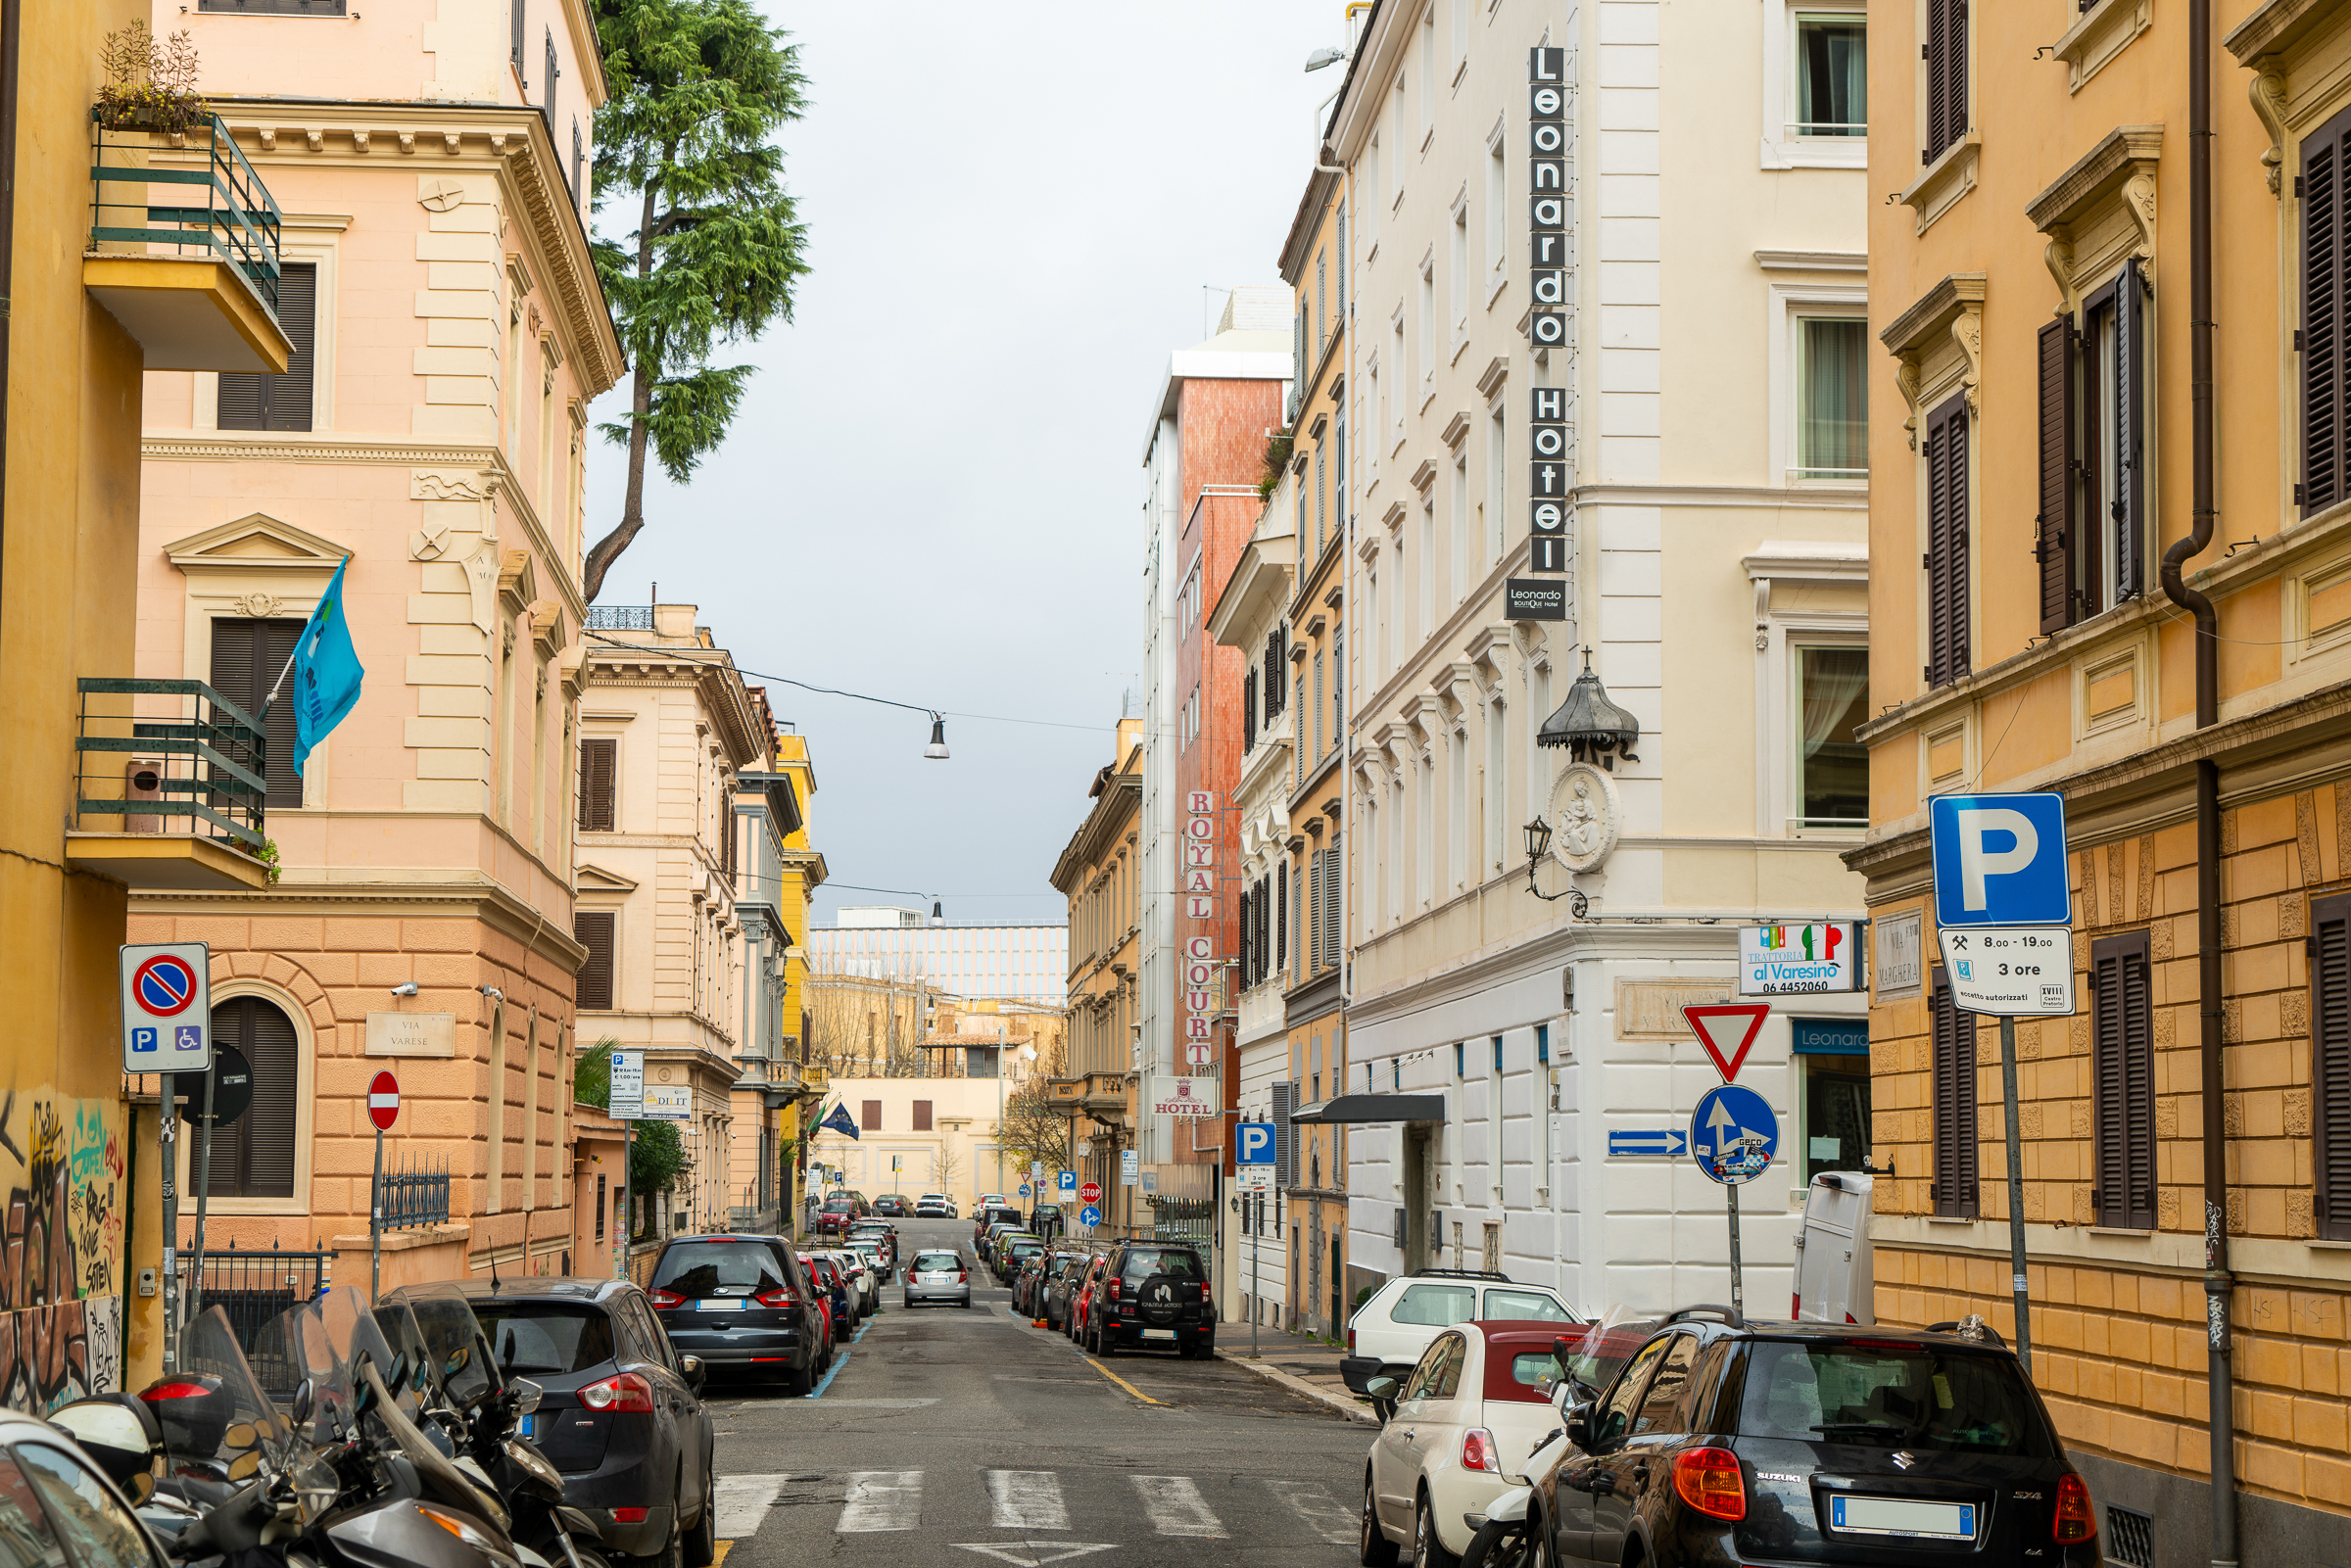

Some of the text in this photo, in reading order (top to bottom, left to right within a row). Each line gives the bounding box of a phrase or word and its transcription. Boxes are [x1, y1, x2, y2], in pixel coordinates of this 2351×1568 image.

[1535, 48, 1562, 569] Leonardo Hotel
[1511, 589, 1561, 600] Leonardo
[1958, 808, 2039, 912] P
[1188, 793, 1211, 1064] ROYAL COURT
[1892, 932, 1903, 950] VIA
[1984, 936, 2009, 948] 8.00
[2022, 936, 2053, 948] 19.00
[1748, 951, 1803, 963] TRATTORIA
[1753, 961, 1838, 980] al Varesino
[1878, 963, 1918, 986] MARGHERA
[1998, 963, 2041, 975] 3 ore
[1763, 980, 1829, 992] 06 4452060
[2041, 986, 2062, 995] XVIII
[1663, 993, 1693, 1006] VIA
[1960, 990, 2028, 1002] eccetto autorizzati
[137, 1030, 152, 1049] P
[1802, 1029, 1870, 1046] Leonard
[615, 1056, 622, 1065] P
[1155, 1104, 1212, 1115] HOTEL
[1243, 1127, 1269, 1160] P
[1061, 1173, 1074, 1188] P
[1756, 1472, 1801, 1483] SUZUKI
[2013, 1491, 2042, 1500] SX4
